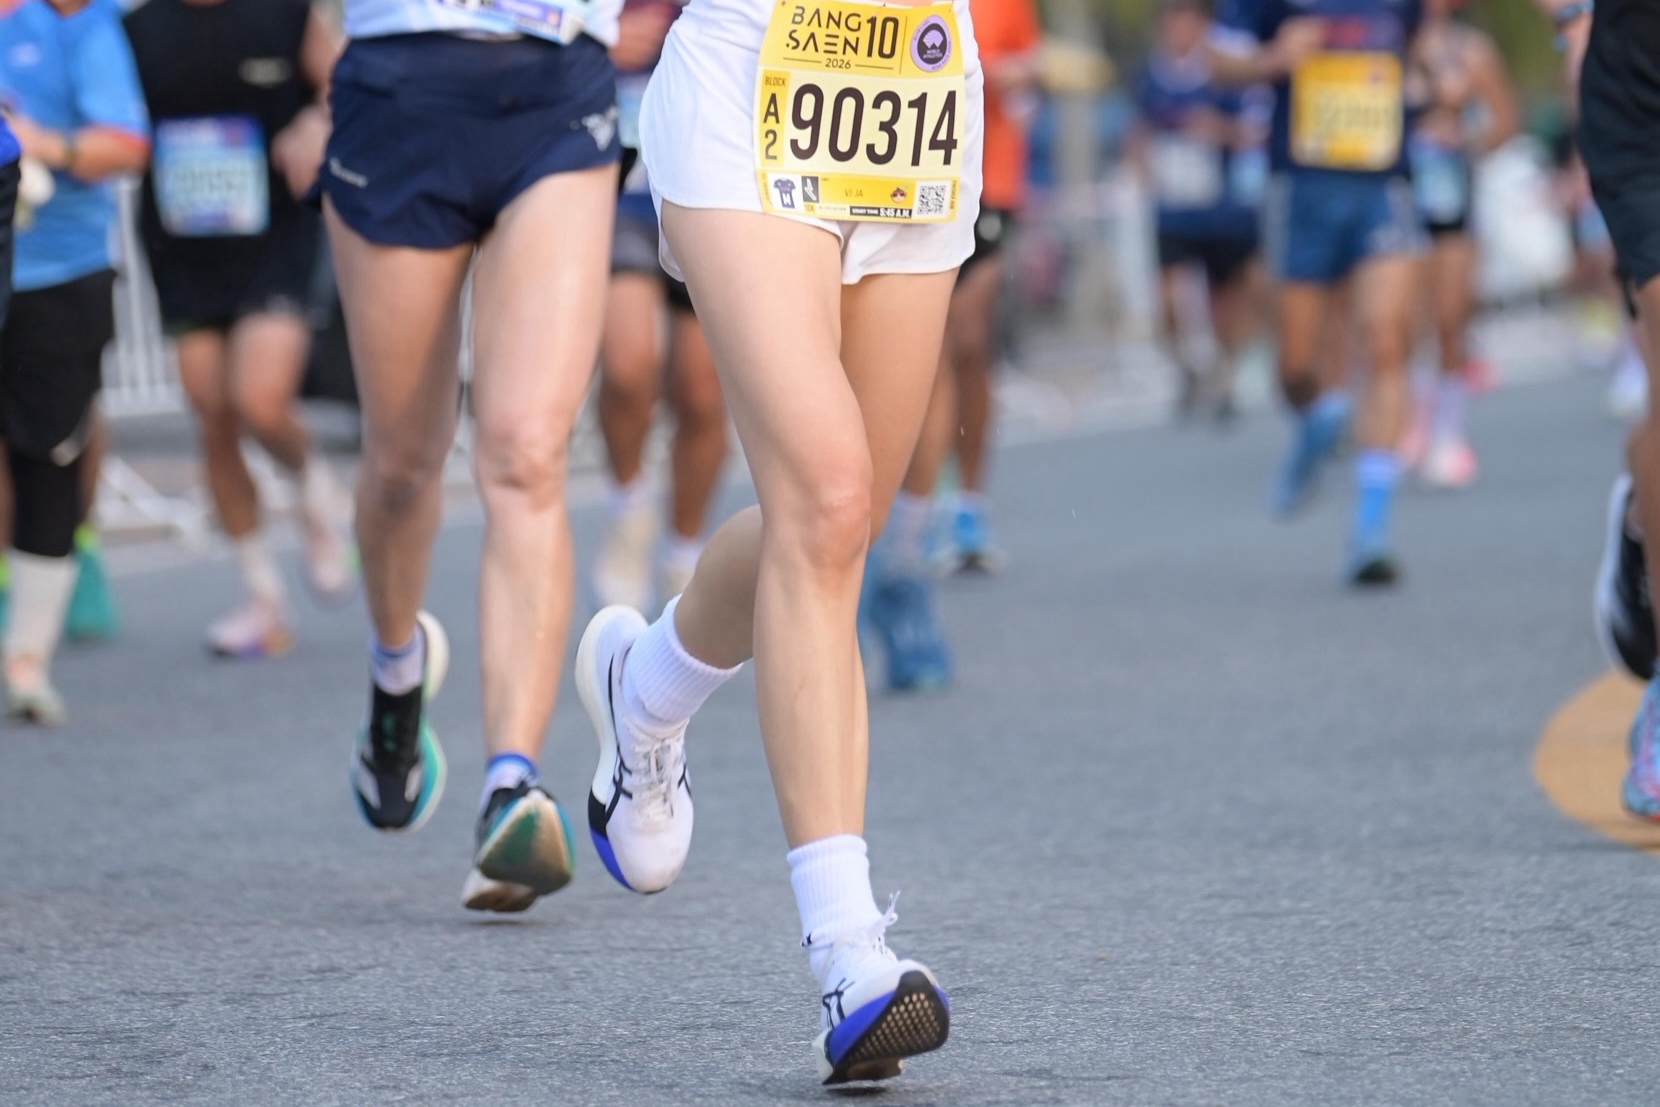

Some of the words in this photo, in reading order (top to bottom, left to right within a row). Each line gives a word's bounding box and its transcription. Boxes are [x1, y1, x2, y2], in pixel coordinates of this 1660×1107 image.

[791, 5, 862, 32] BANG
[786, 29, 860, 56] SAEN
[866, 15, 899, 59] 10
[825, 58, 852, 70] 2026
[764, 76, 786, 86] BLOCK
[789, 83, 958, 167] 90314
